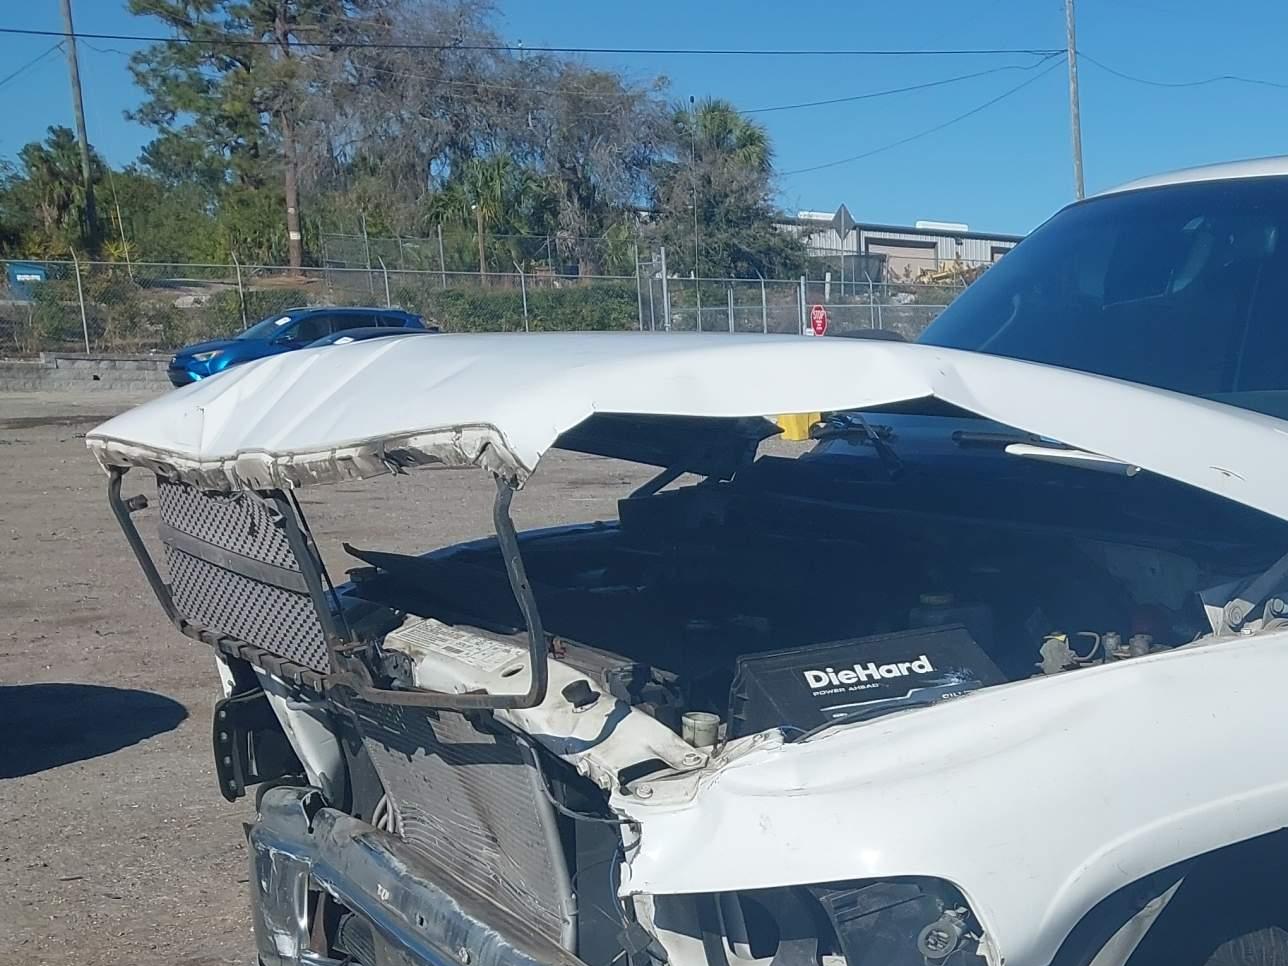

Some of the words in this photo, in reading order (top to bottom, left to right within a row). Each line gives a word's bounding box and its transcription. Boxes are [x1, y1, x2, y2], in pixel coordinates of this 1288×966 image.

[812, 310, 825, 320] STOP
[803, 655, 935, 689] DieHard
[812, 687, 846, 696] POWER
[848, 683, 879, 691] AHEAD
